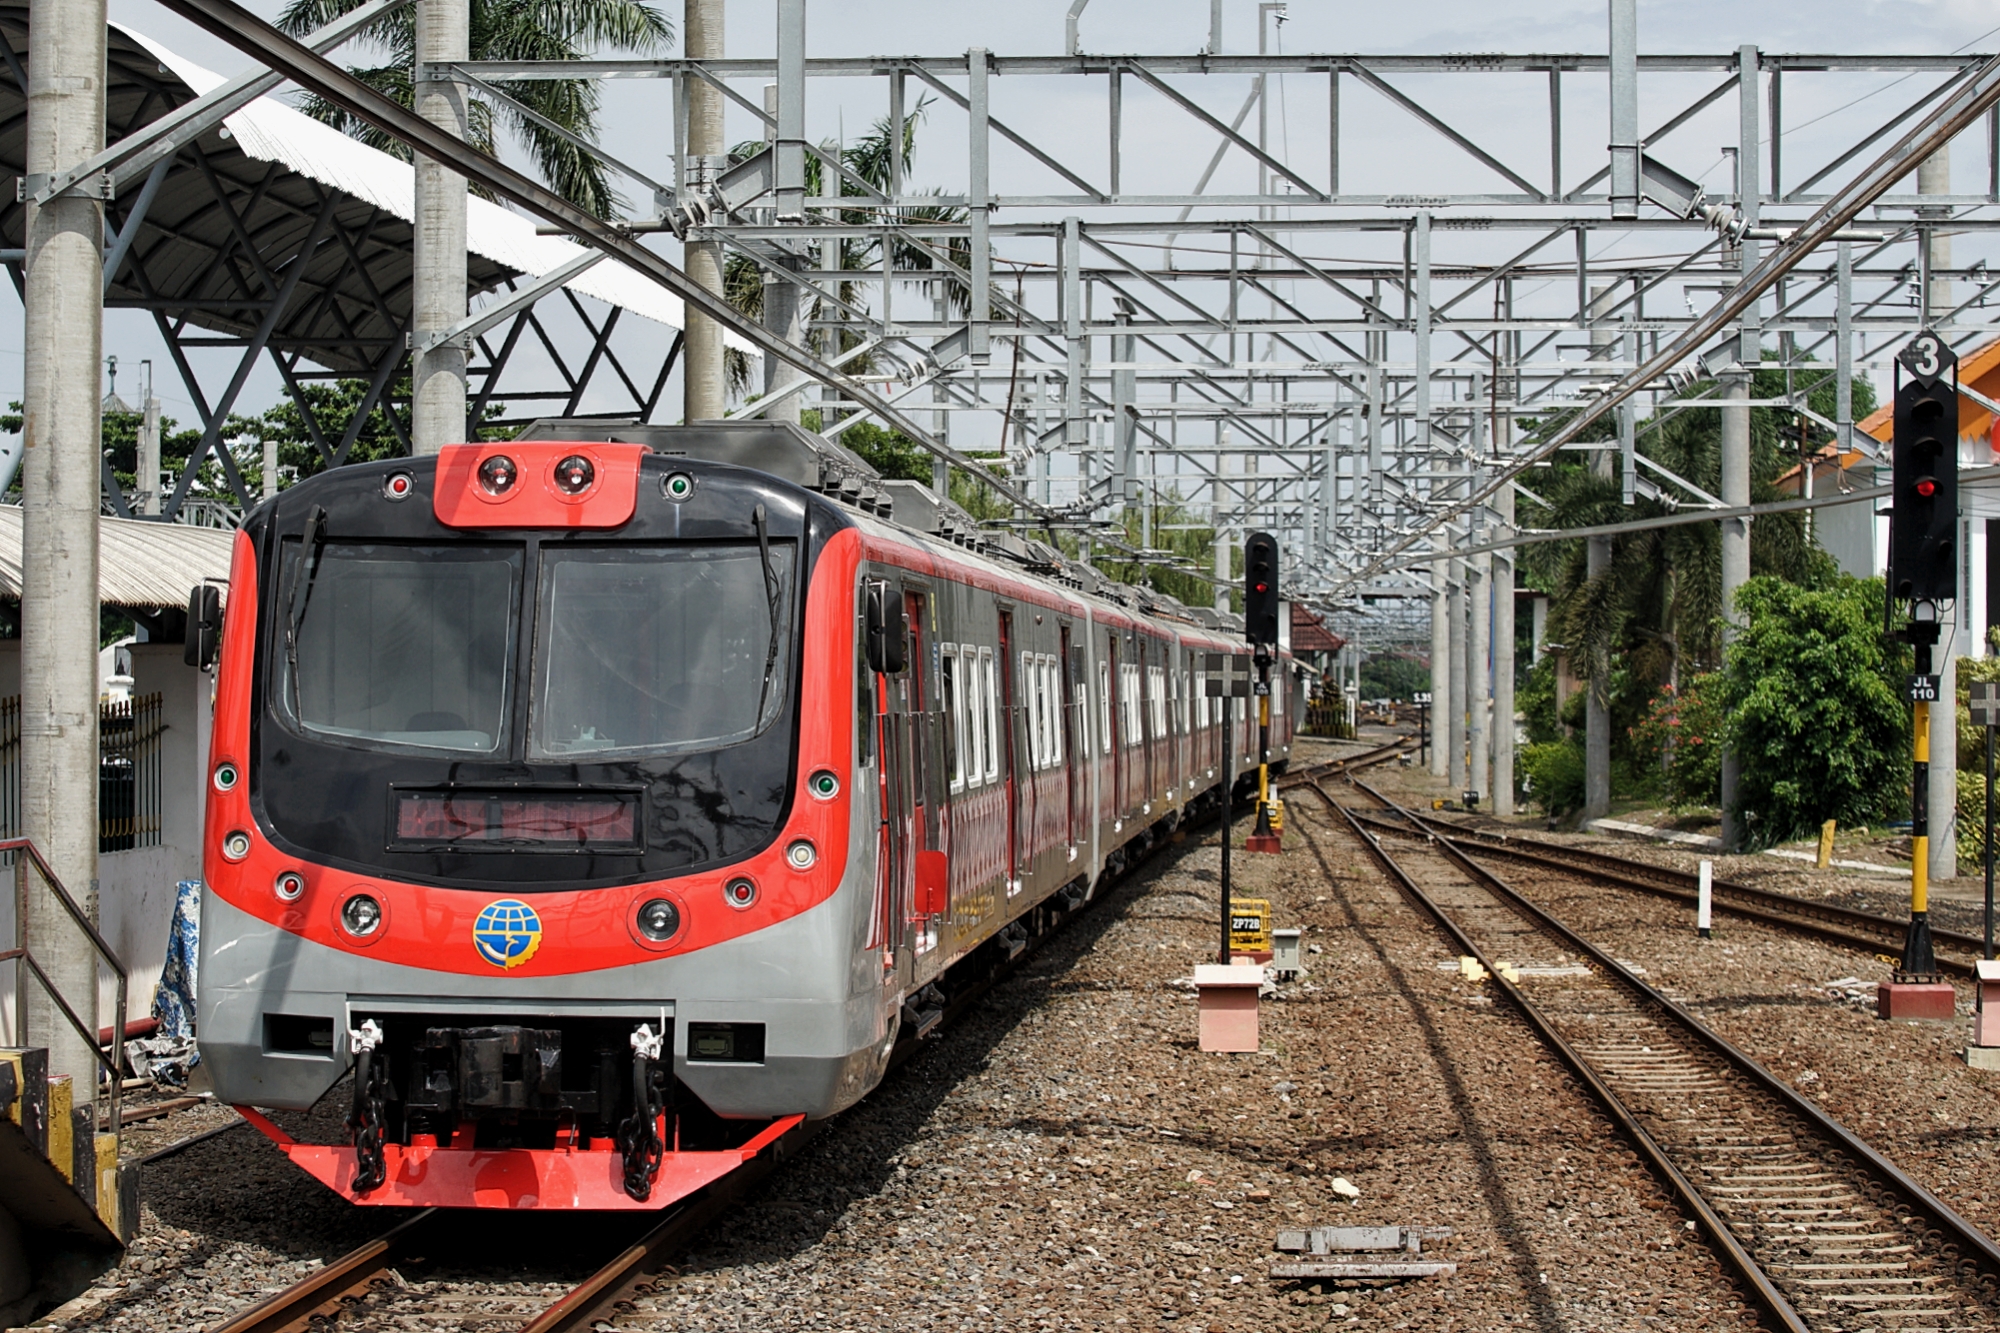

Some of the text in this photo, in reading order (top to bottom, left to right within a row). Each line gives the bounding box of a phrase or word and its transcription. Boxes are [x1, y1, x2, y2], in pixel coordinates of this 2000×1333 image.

[1915, 337, 1939, 376] 3
[1913, 677, 1931, 687] JL
[1910, 689, 1935, 699] 110
[1232, 918, 1260, 930] ZP72B
